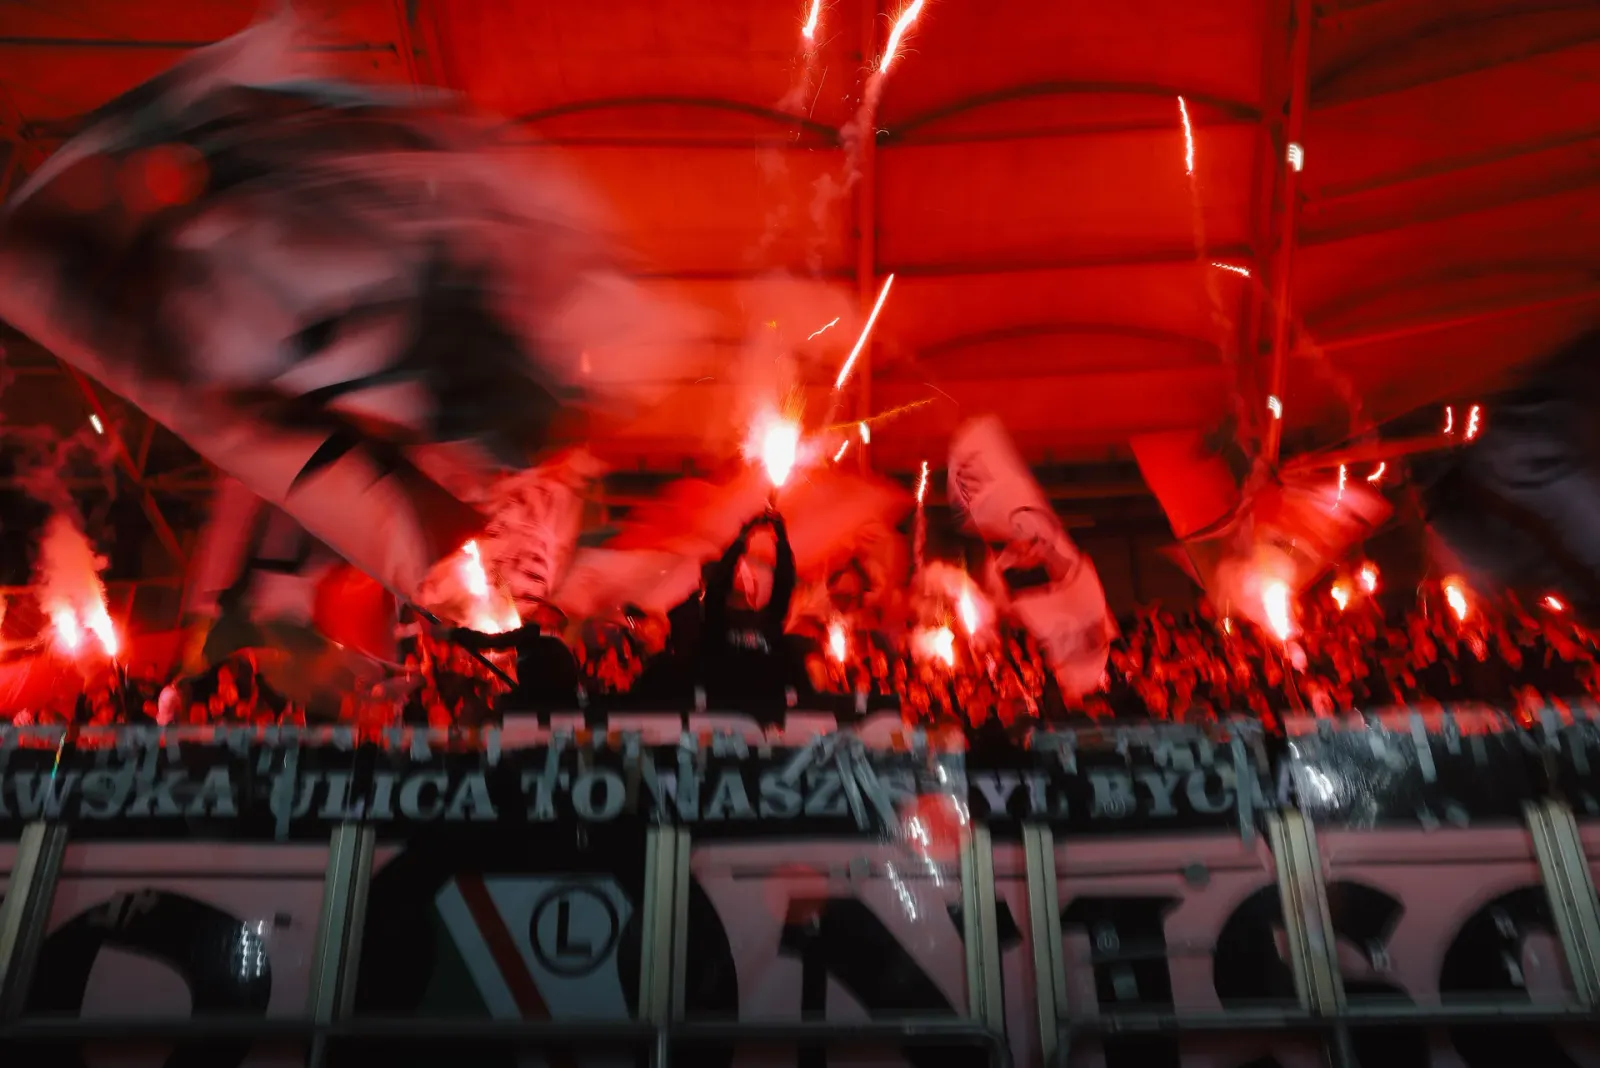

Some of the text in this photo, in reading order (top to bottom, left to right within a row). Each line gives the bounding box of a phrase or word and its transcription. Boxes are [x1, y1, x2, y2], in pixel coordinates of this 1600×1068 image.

[270, 771, 498, 820] ULICA
[520, 770, 627, 821] TO
[648, 769, 849, 820] NASZ
[555, 899, 592, 957] L
